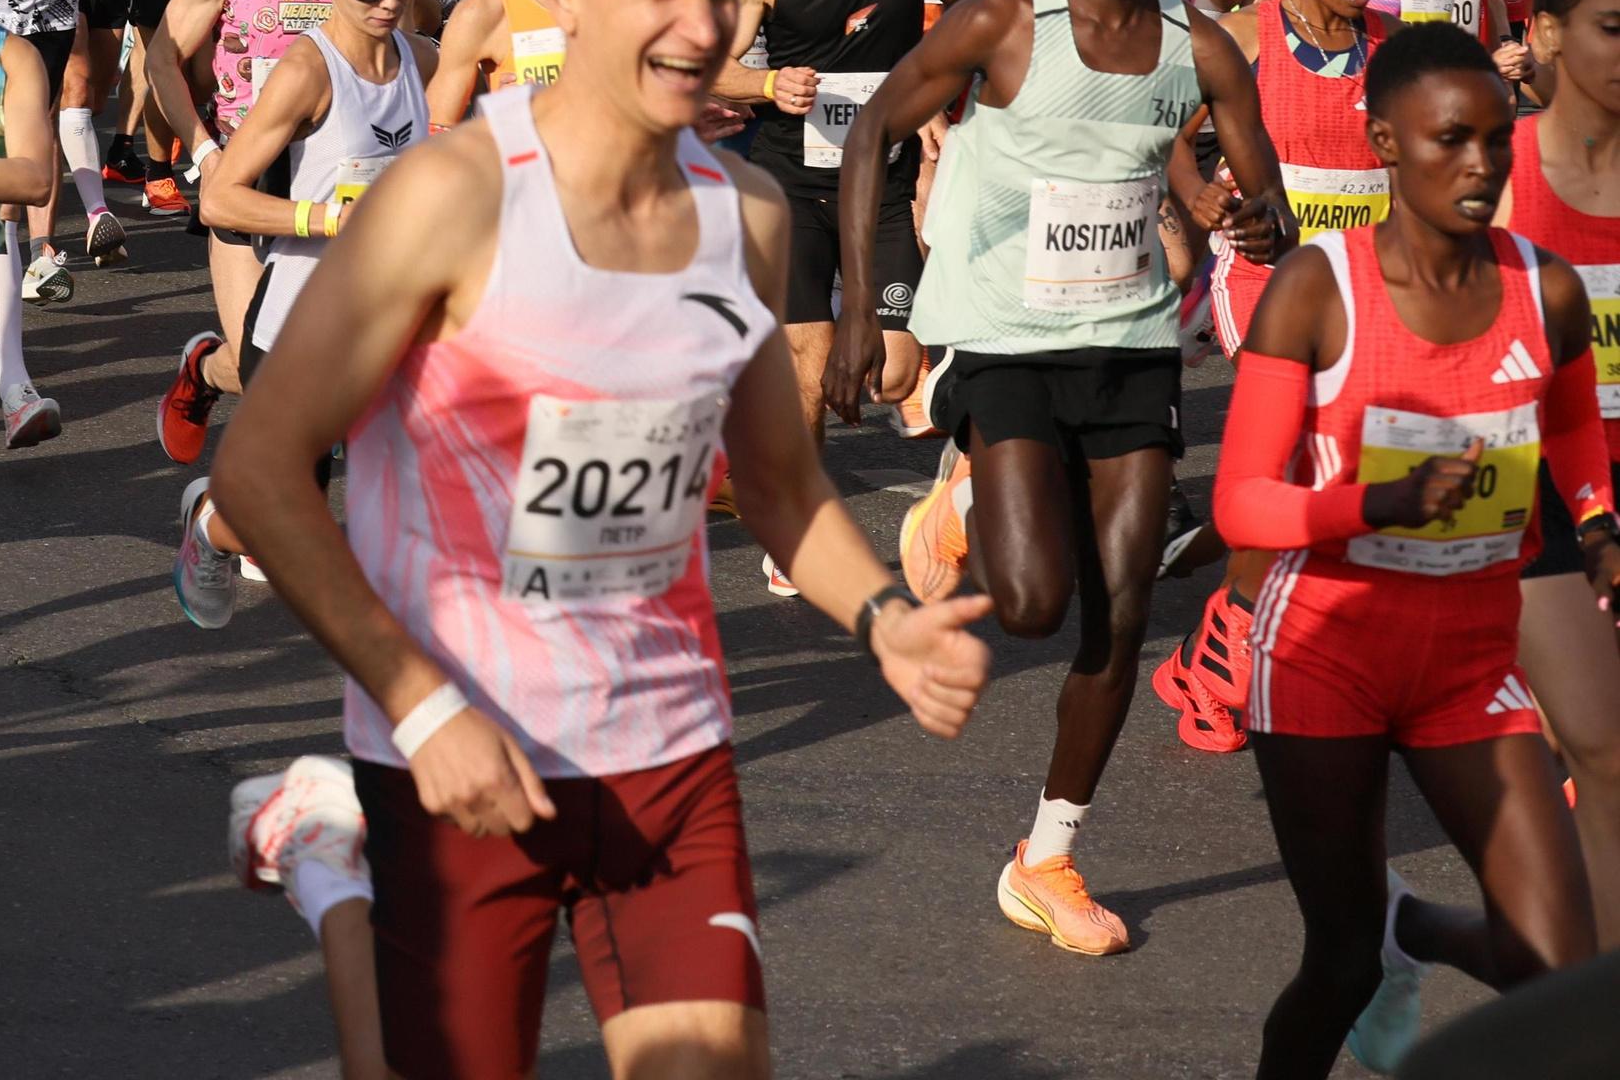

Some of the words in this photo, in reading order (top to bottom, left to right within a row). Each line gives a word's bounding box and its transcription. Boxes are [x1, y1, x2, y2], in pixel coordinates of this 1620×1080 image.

[1340, 183, 1365, 195] 42,2
[1106, 197, 1134, 211] 42,2
[1297, 202, 1371, 229] WARIYO
[1045, 217, 1148, 252] KOSITANY
[525, 442, 711, 519] 20214
[599, 525, 647, 544] ПЕТР
